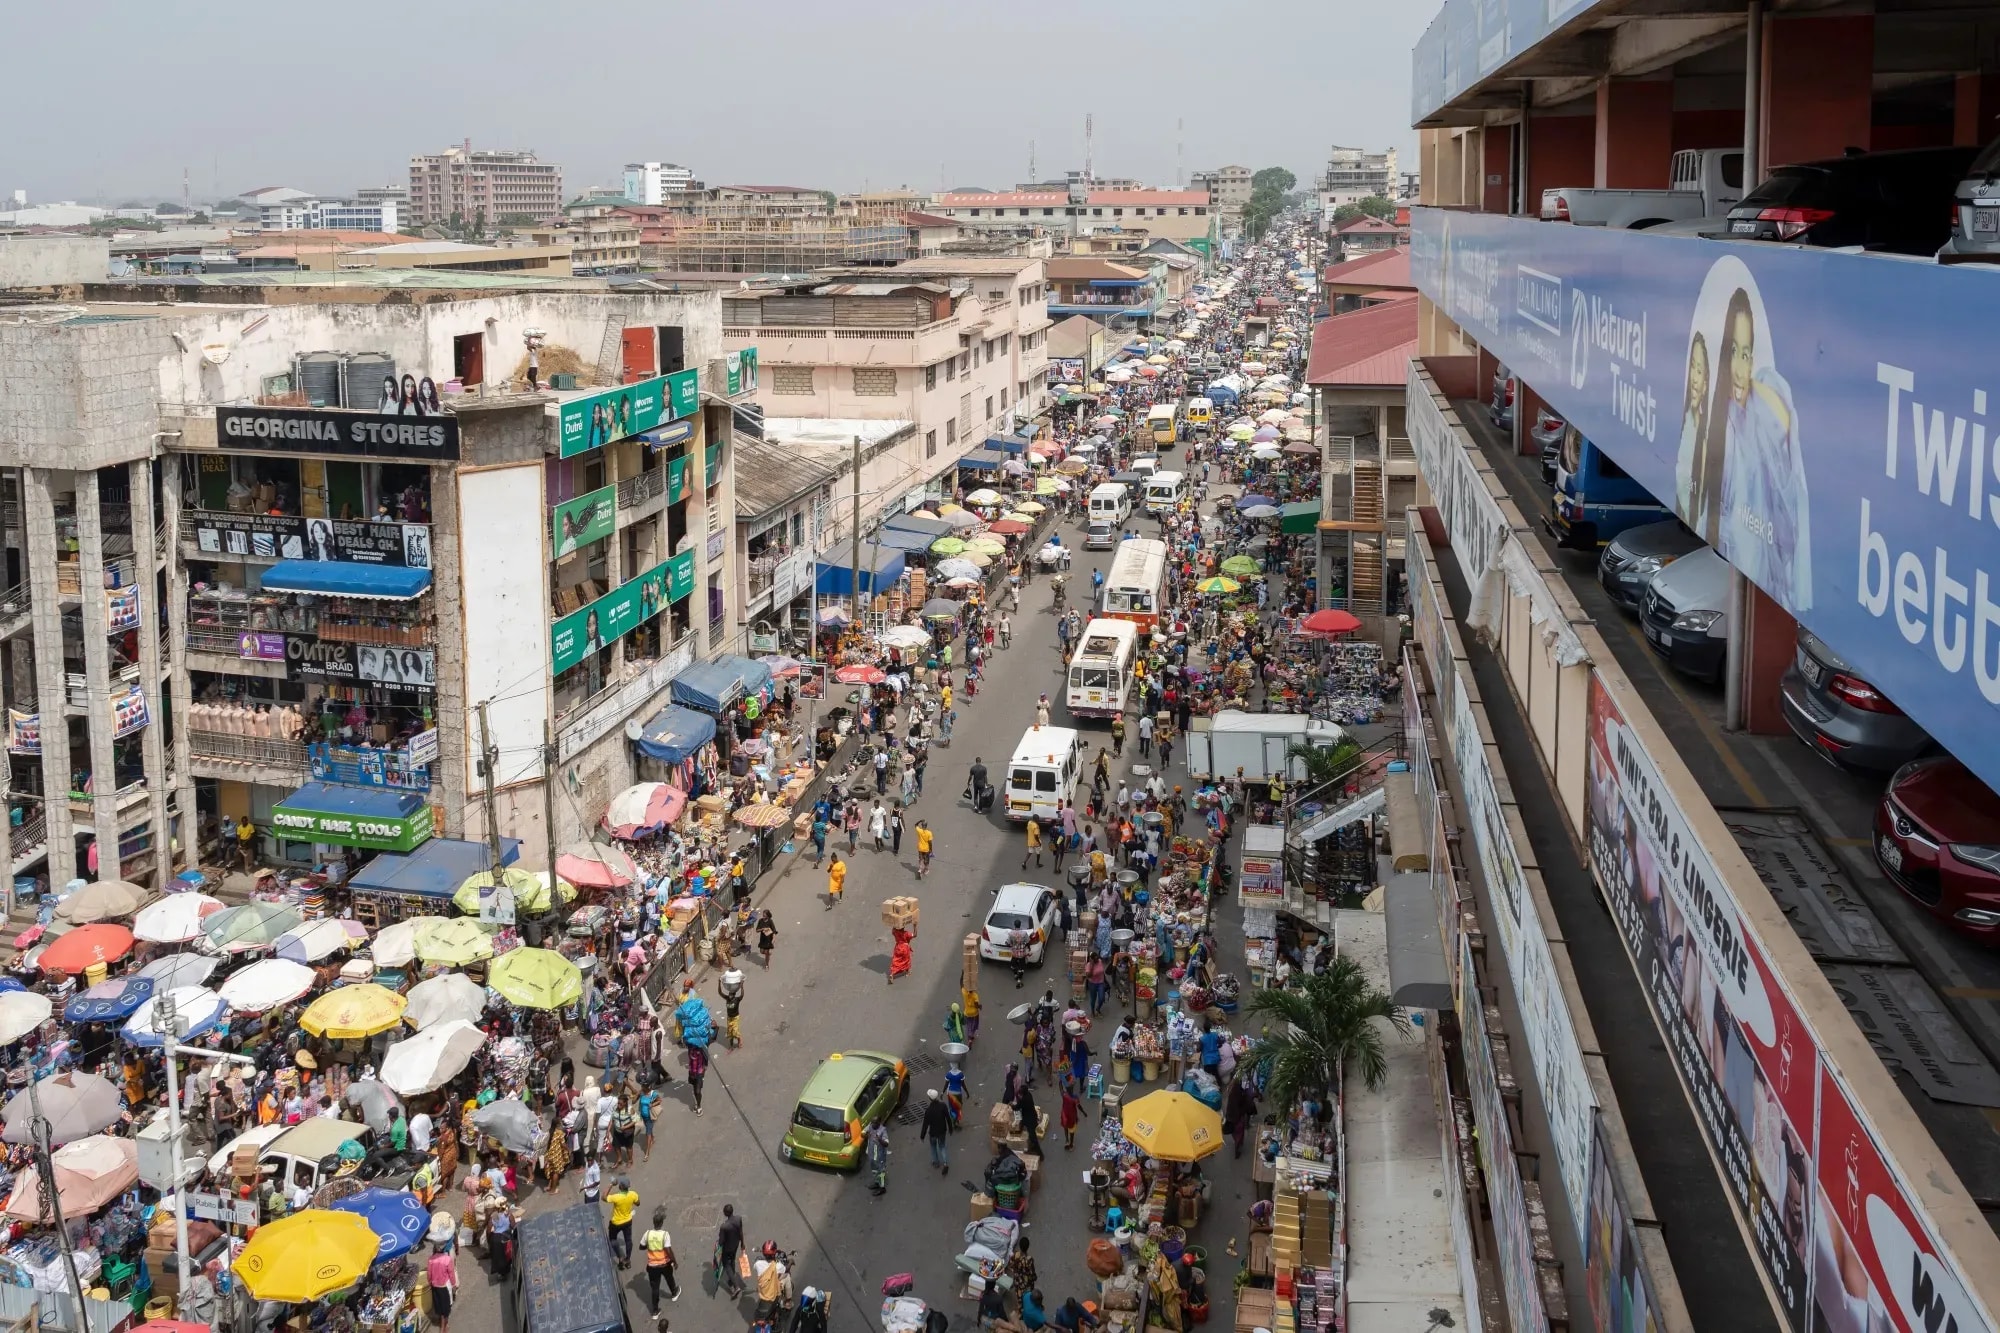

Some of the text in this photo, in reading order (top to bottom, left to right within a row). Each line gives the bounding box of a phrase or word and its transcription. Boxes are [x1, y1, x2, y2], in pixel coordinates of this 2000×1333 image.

[1519, 278, 1558, 320] DARLING
[1591, 295, 1647, 369] Natural
[1610, 362, 1657, 442] Twist
[225, 416, 446, 447] GEORGINA STORES
[193, 511, 209, 520] HAIR
[210, 513, 254, 523] ACCESSORIES
[263, 517, 300, 526] WIGTOOLS
[252, 524, 273, 532] DEALS
[1741, 504, 1774, 544] Week 8
[333, 522, 400, 539] BEST HAIR
[337, 536, 374, 549] DEALS
[302, 667, 326, 675] GOLDEN
[325, 662, 353, 672] BRAID
[273, 813, 401, 837] CANDY HAIR TOOLS
[409, 806, 431, 825] CANDY
[412, 825, 435, 843] TOOLS
[413, 818, 429, 833] HAIR
[1617, 730, 1748, 996] WINI'S BRA & LINGERIE
[1673, 876, 1684, 904] Our
[1685, 900, 1707, 950] Business
[1709, 941, 1725, 984] Today
[1629, 922, 1642, 959] 777
[1657, 989, 1671, 1024] SHOP
[1698, 1084, 1724, 1150] GROUND
[1725, 1144, 1749, 1207] FLOOR
[1750, 1202, 1769, 1256] GATE
[1787, 1285, 1794, 1309] 9
[1682, 1018, 1709, 1086] SHOPPING
[1710, 1081, 1726, 1126] MALL
[1729, 1123, 1751, 1180] ACCRA
[1760, 1196, 1790, 1271] GHANA,
[196, 1198, 217, 1209] Rabito
[252, 1258, 260, 1269] MTN
[322, 1268, 336, 1276] MTN
